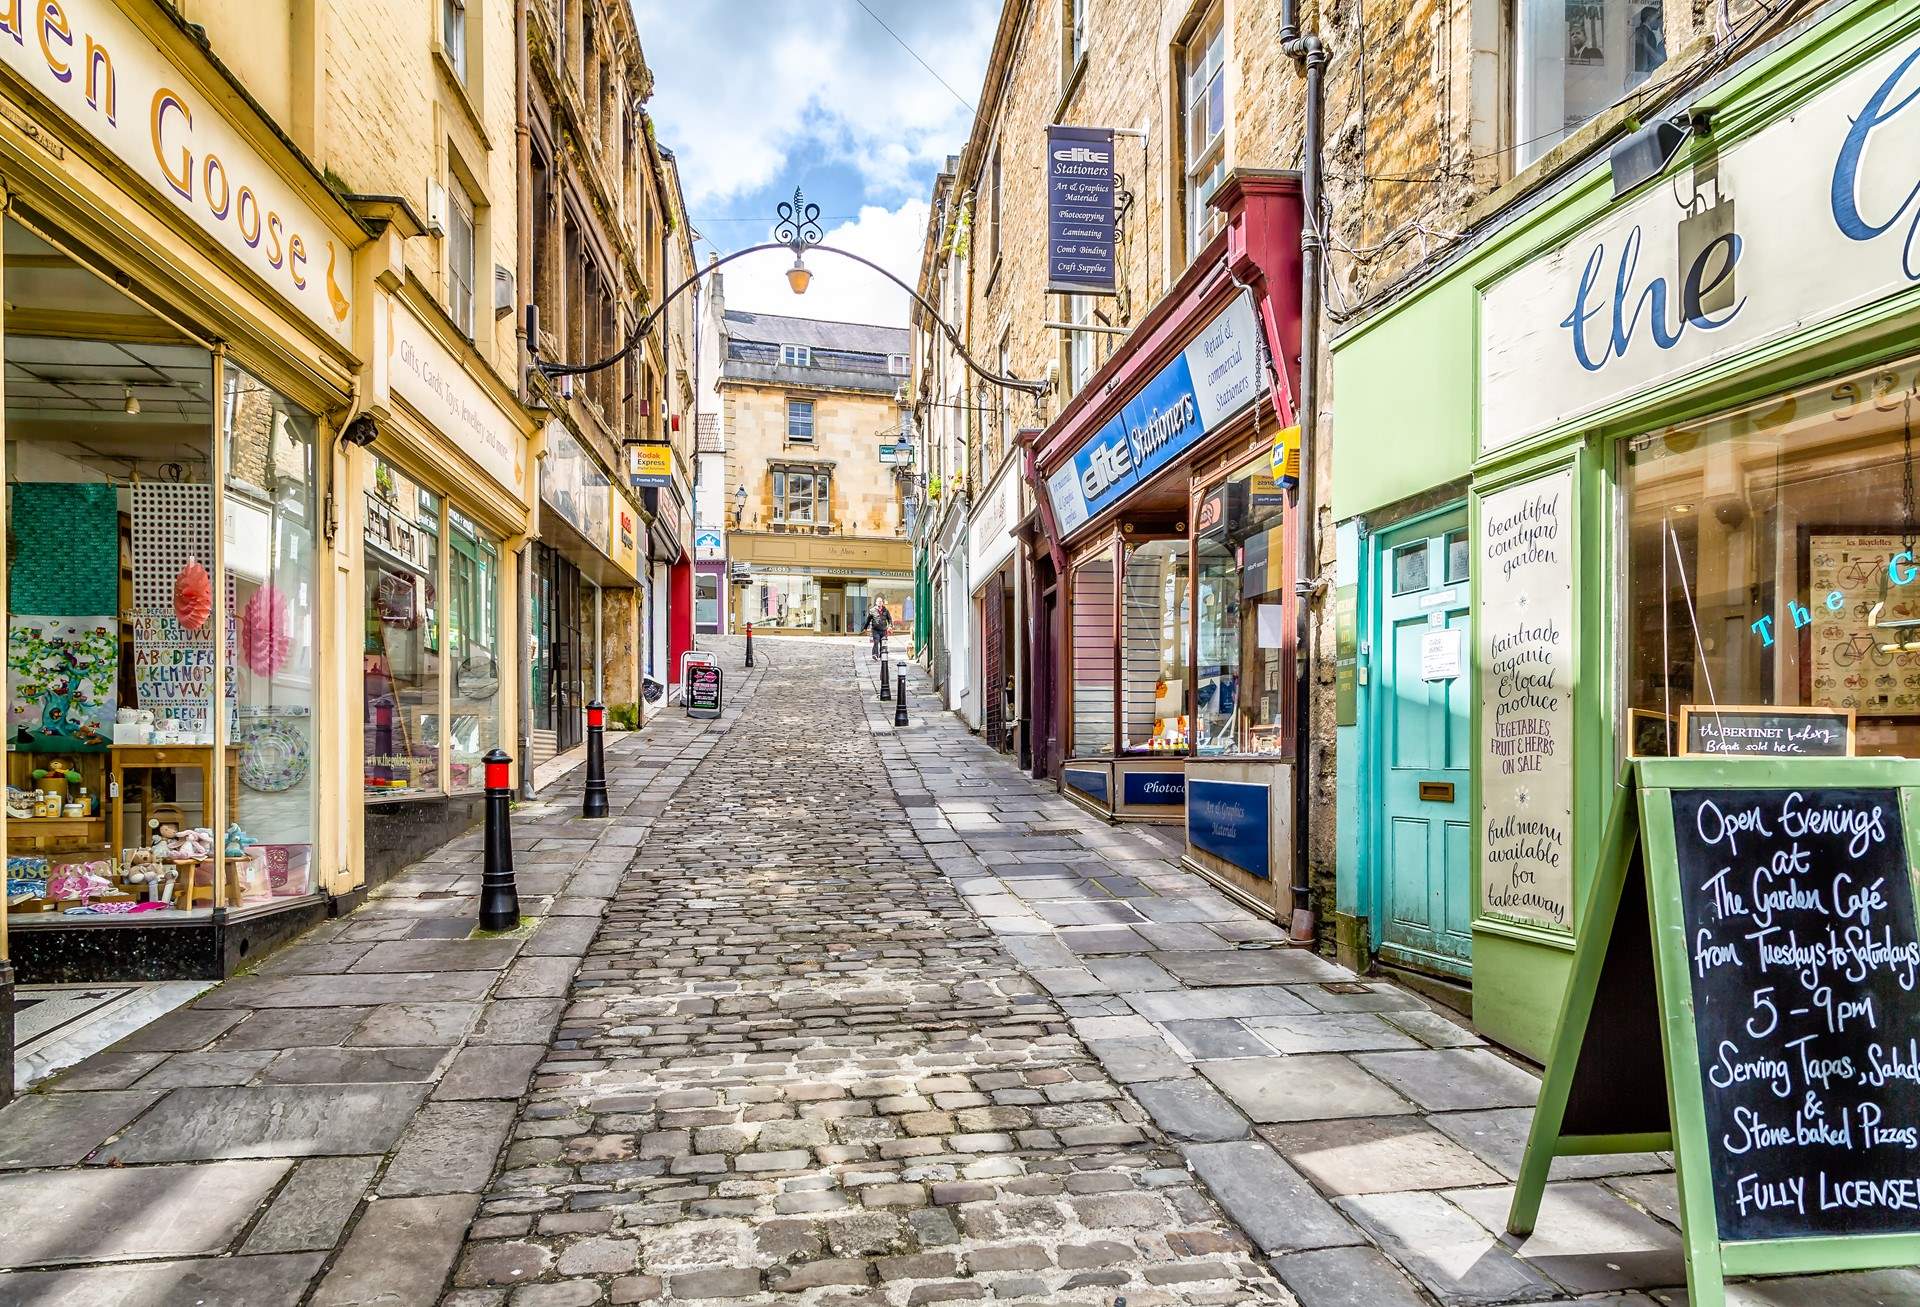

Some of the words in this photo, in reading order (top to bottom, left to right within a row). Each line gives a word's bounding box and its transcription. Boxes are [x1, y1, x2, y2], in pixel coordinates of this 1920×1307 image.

[1053, 147, 1109, 164] elite
[1054, 163, 1109, 176] Stationers
[150, 87, 307, 291] Goose
[1054, 182, 1068, 191] Art
[1079, 183, 1109, 194] Graphics
[1065, 193, 1099, 202] Materials
[1059, 210, 1105, 223] Photocopying
[1062, 228, 1102, 239] Laminating
[1056, 245, 1077, 254] Comb
[1079, 246, 1107, 257] Binding
[1057, 262, 1076, 272] Craft
[1077, 263, 1106, 273] Supplies
[1560, 225, 1748, 372] the
[1204, 323, 1224, 358] Retail
[1224, 317, 1234, 339] &
[401, 339, 420, 377] Gifts,
[1207, 341, 1242, 387] commercial
[1216, 376, 1249, 412] Stationers
[1081, 438, 1133, 502] elite
[1131, 392, 1196, 467] Stationers
[1488, 493, 1558, 538] beautiful
[1488, 519, 1558, 559] courtyard
[1503, 541, 1558, 583] garden
[1491, 618, 1560, 660] fairtrade
[1492, 646, 1552, 682] organic
[1515, 667, 1555, 692] local
[1496, 688, 1558, 724] produce
[1491, 738, 1516, 757] FRUIT
[1517, 738, 1524, 754] &
[1525, 736, 1554, 756] HERBS
[1699, 723, 1719, 737] the
[1722, 727, 1783, 738] BERTINET
[1745, 741, 1768, 751] sold
[1774, 741, 1806, 753] here.
[1502, 759, 1515, 775] ON
[1517, 755, 1543, 773] SALE
[1205, 800, 1214, 817] Art
[1221, 801, 1246, 821] Graphics
[1697, 799, 1773, 856] Open
[1778, 791, 1886, 858] Evenings
[1211, 823, 1237, 839] Materials
[1488, 815, 1516, 846] full
[1517, 821, 1562, 846] menu
[1489, 838, 1559, 868] available
[1772, 842, 1811, 875] at
[1512, 862, 1536, 889] for
[1701, 867, 1749, 919] The
[1752, 867, 1829, 928] Garden
[1833, 872, 1888, 926] Café
[1694, 927, 1743, 978] from
[1745, 926, 1827, 990] Tuesdays
[1746, 986, 1778, 1038] 5
[1813, 986, 1876, 1034] 9pm
[1709, 1040, 1791, 1098] Serving
[1804, 1090, 1825, 1120] &
[1857, 1102, 1917, 1149] Pizzas
[1736, 1173, 1806, 1217] FULLY
